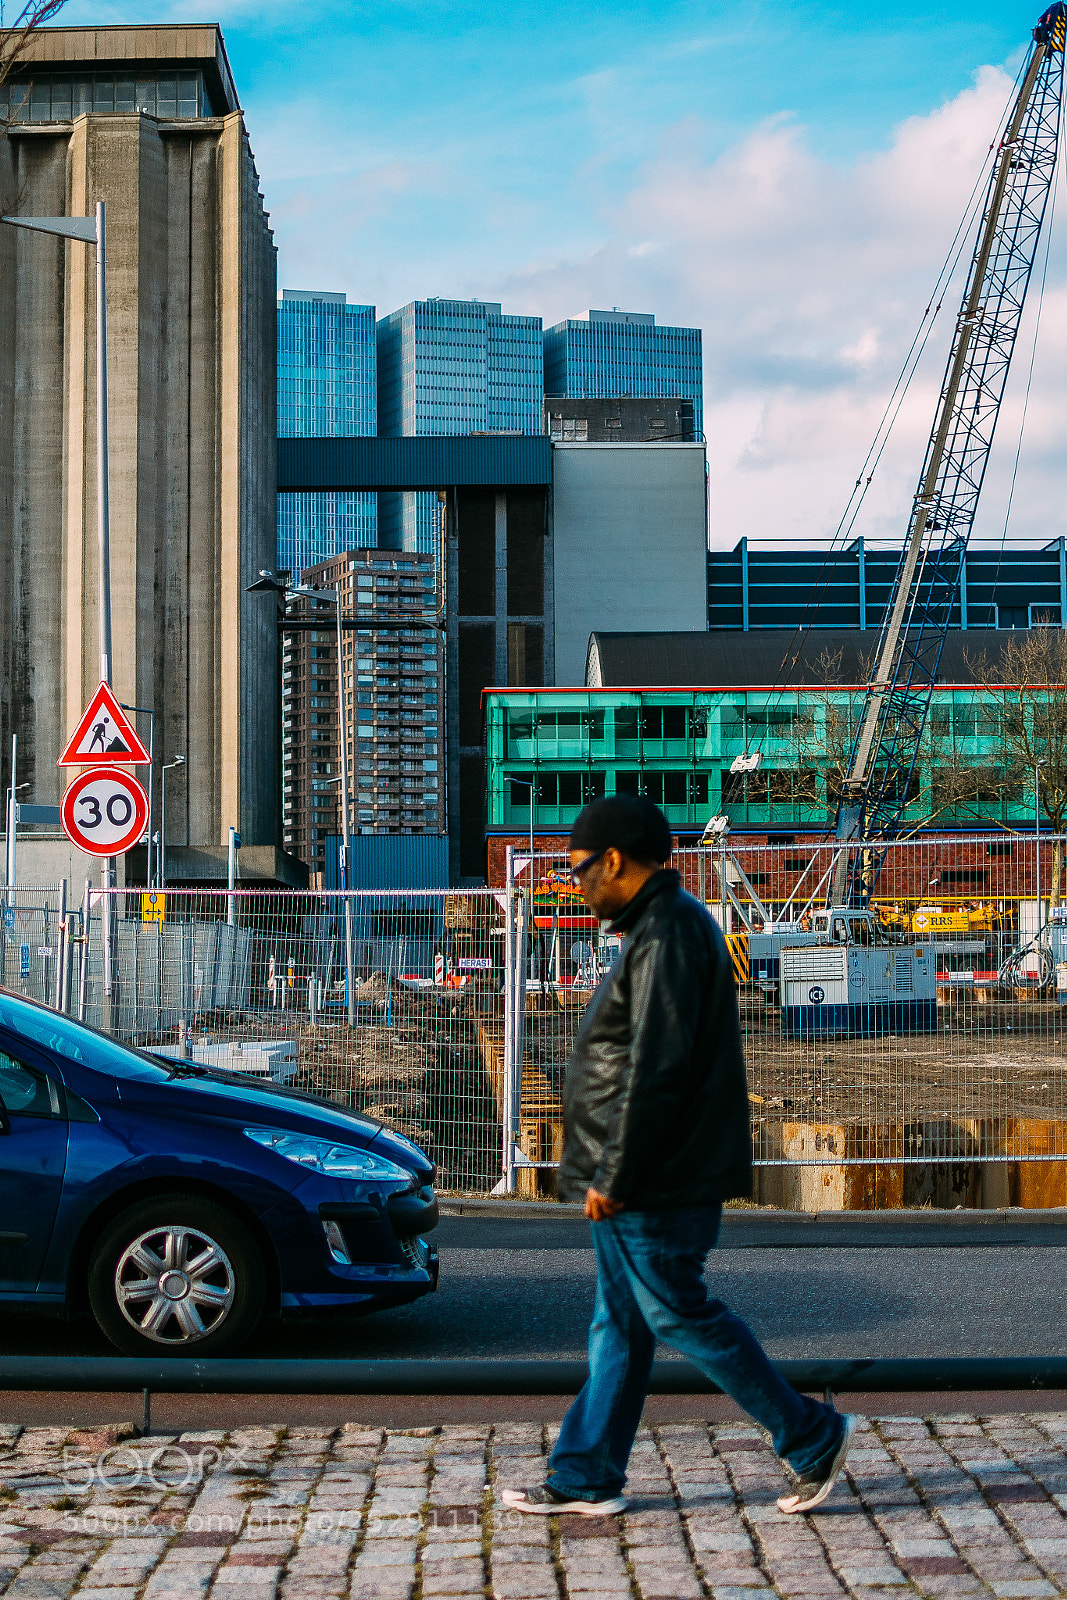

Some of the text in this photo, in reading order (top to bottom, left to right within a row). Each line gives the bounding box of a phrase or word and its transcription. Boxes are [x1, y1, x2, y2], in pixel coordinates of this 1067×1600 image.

[77, 793, 132, 828] 30
[930, 916, 953, 926] RRS
[461, 959, 487, 967] HERAS
